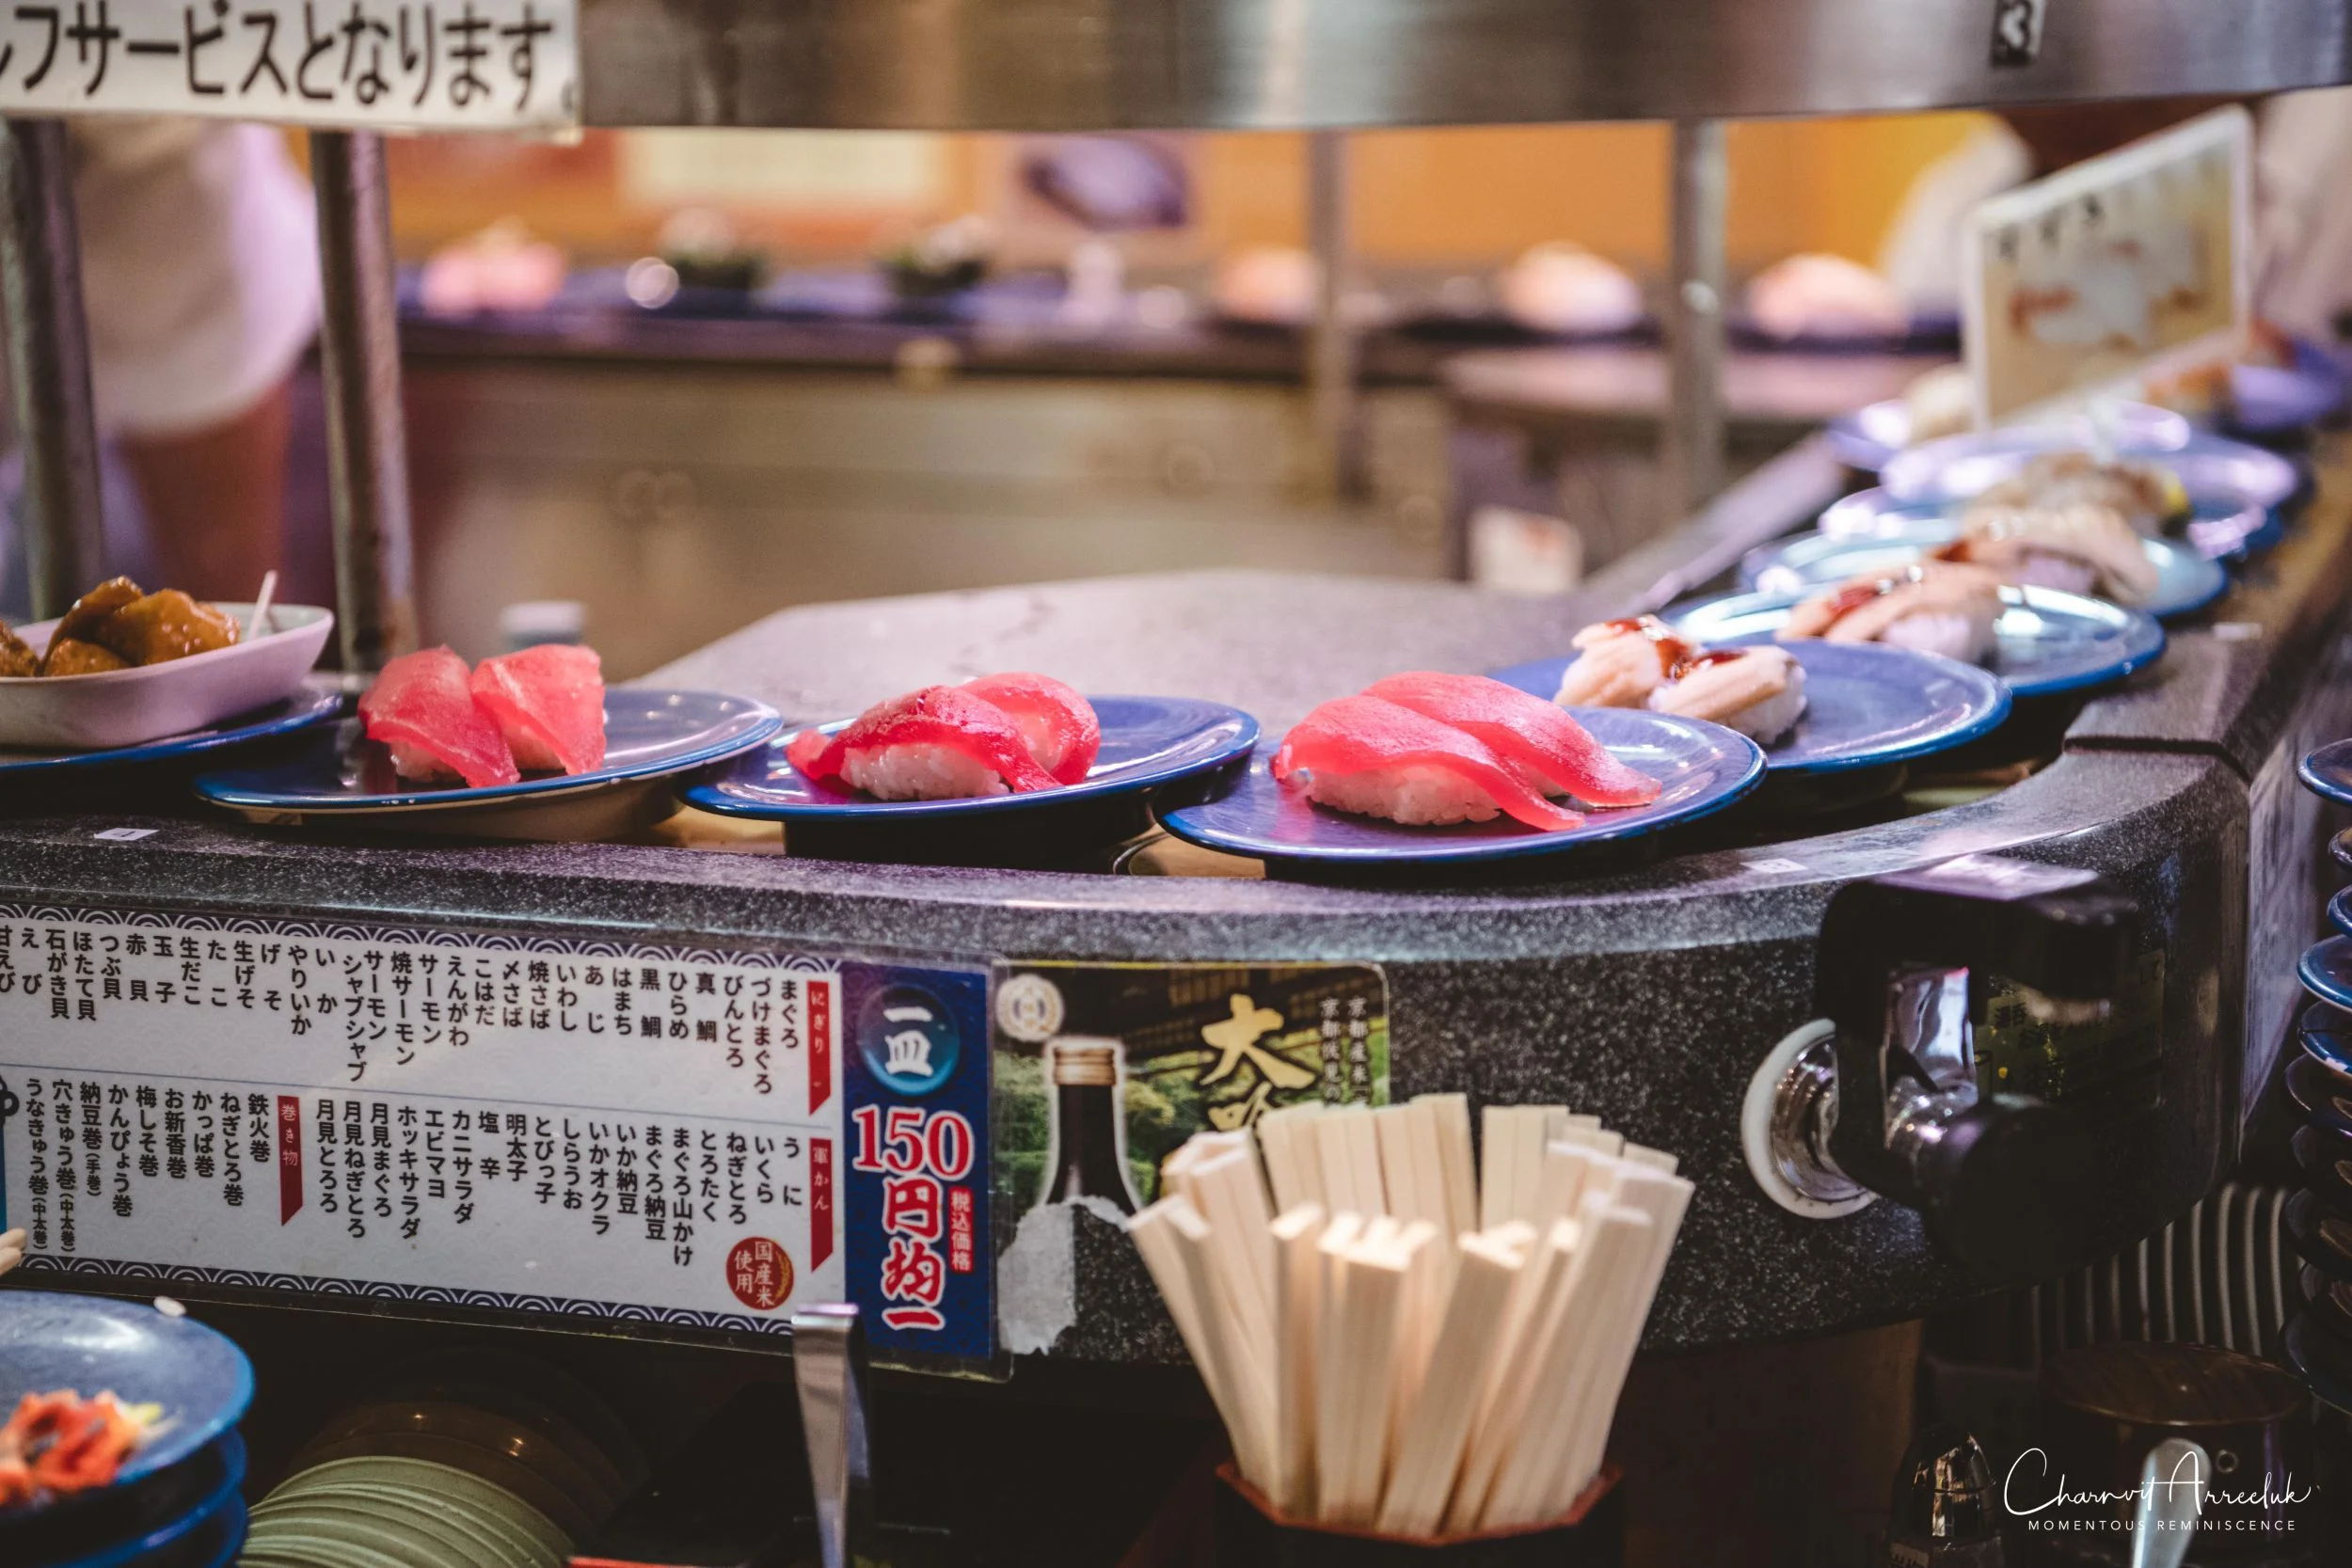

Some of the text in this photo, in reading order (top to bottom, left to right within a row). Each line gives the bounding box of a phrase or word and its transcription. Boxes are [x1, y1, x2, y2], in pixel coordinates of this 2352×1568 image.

[0, 925, 16, 992] 甘えび
[22, 927, 42, 994] えび
[45, 929, 70, 1020] 石がき貝
[73, 931, 97, 1022] ほたて貝
[100, 936, 122, 1000] つぶ貝
[126, 933, 149, 1002] 赤貝
[153, 936, 176, 1003] 玉子
[180, 937, 200, 1005] 生だこ
[207, 940, 227, 1006] たこ
[233, 941, 255, 1008] 生げそ
[262, 943, 281, 1010] げそ
[288, 945, 311, 1035] やりいか
[316, 949, 338, 1014] いか
[364, 950, 387, 1039] サーモン
[475, 957, 495, 1025] こはだ
[503, 960, 522, 1027] 〆さば
[528, 960, 550, 1029] 焼さば
[343, 956, 367, 1082] シャブシャブ
[390, 951, 414, 1065] 焼サーモン
[419, 954, 441, 1043] サーモン
[448, 956, 469, 1046] えんがわ
[557, 965, 578, 1031] いわし
[585, 966, 604, 1034] あじ
[612, 968, 632, 1036] はまち
[640, 969, 661, 1038] 黒鯛
[669, 972, 689, 1038] ひらめ
[696, 973, 717, 1042] 真鯛
[723, 975, 744, 1068] びんとろ
[752, 977, 771, 1094] づけまぐろ
[780, 979, 799, 1050] まぐろ
[811, 990, 825, 1053] にぎり
[883, 1006, 933, 1076] 一皿
[108, 1085, 133, 1217] かんぴょう巻
[135, 1085, 159, 1177] 梅しそ巻
[165, 1088, 187, 1179] お新香巻
[192, 1090, 215, 1178] かっぱ巻
[220, 1093, 244, 1206] ねぎとろ巻
[248, 1093, 270, 1163] 鉄火巻
[281, 1104, 298, 1166] 巻き物
[316, 1100, 338, 1212] 月見とろろ
[371, 1103, 391, 1217] 月見まぐろ
[425, 1110, 445, 1198] エビマヨ
[478, 1111, 501, 1180] 塩辛
[506, 1114, 528, 1181] 明太子
[534, 1117, 556, 1204] とびっ子
[564, 1118, 583, 1210] しらうお
[851, 1104, 973, 1180] 150
[343, 1101, 365, 1238] 月見ねぎとろ
[398, 1106, 421, 1239] ホッキサラダ
[453, 1110, 474, 1224] カニサラダ
[589, 1122, 610, 1235] いかオクラ
[616, 1125, 638, 1214] いか納豆
[644, 1125, 666, 1241] まぐろ納豆
[673, 1128, 693, 1266] まぐろ山かけ
[701, 1131, 719, 1222] とろたく
[726, 1132, 747, 1225] ねぎとろ
[755, 1136, 774, 1203] いくら
[784, 1137, 802, 1206] うに
[813, 1148, 830, 1211] 軍かん
[882, 1177, 945, 1330] 円均一
[951, 1190, 972, 1271] 税込価格
[734, 1250, 754, 1294] 使用
[755, 1241, 775, 1307] 国産米
